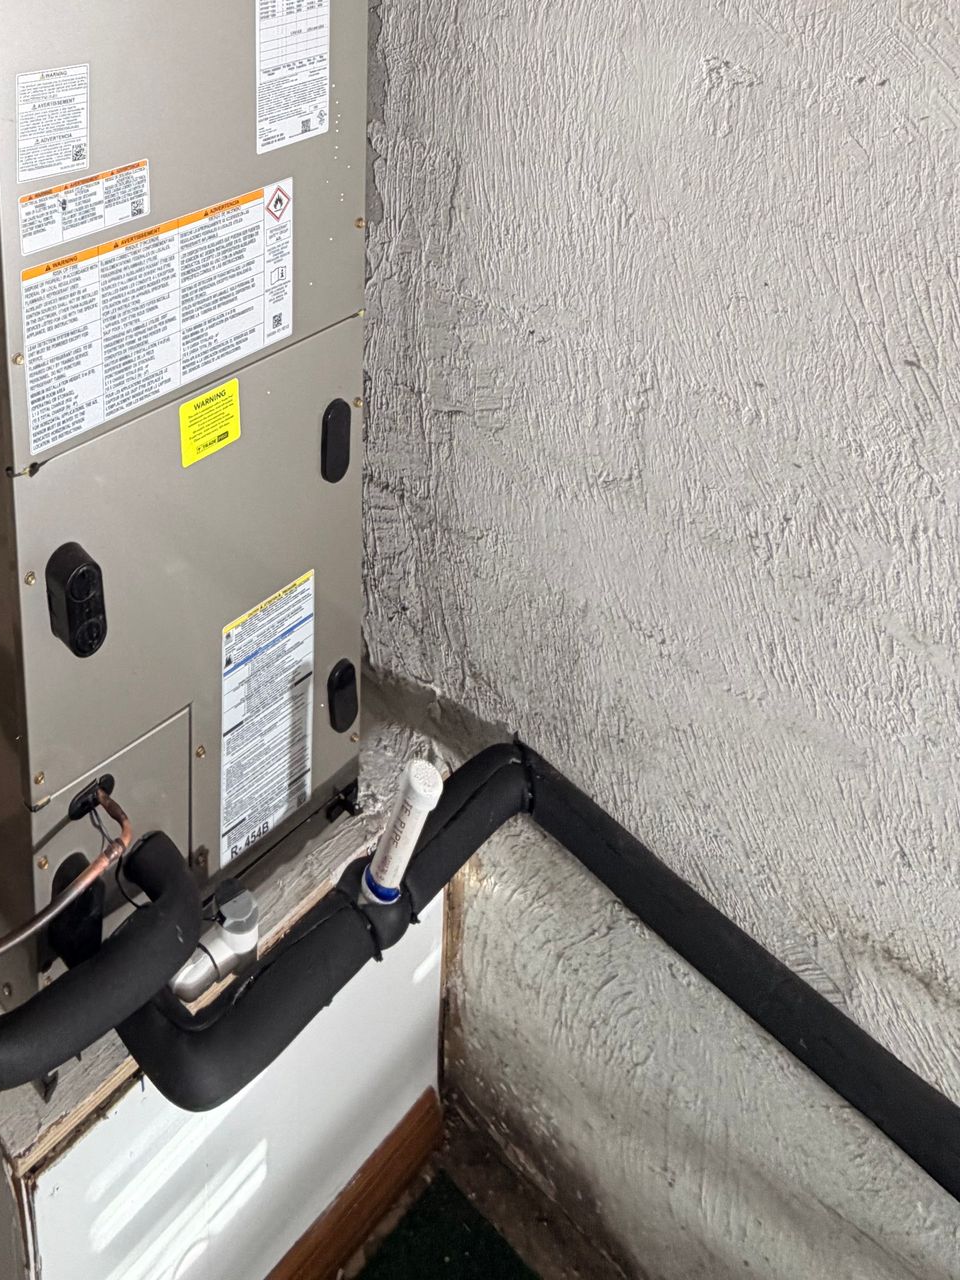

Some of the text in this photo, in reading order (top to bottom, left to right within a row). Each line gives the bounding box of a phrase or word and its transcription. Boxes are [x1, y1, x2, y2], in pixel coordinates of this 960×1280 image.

[46, 70, 67, 78] WARNING
[38, 98, 75, 109] AVERTISSEMENT
[40, 133, 72, 144] ADVERTENCIA
[210, 199, 239, 213] ADVERTENCIA
[121, 226, 160, 245] AVERTISSEMENT
[52, 255, 77, 268] WARNING
[193, 389, 226, 410] WARNING
[245, 822, 268, 847] 454B
[392, 817, 406, 848] PIPE
